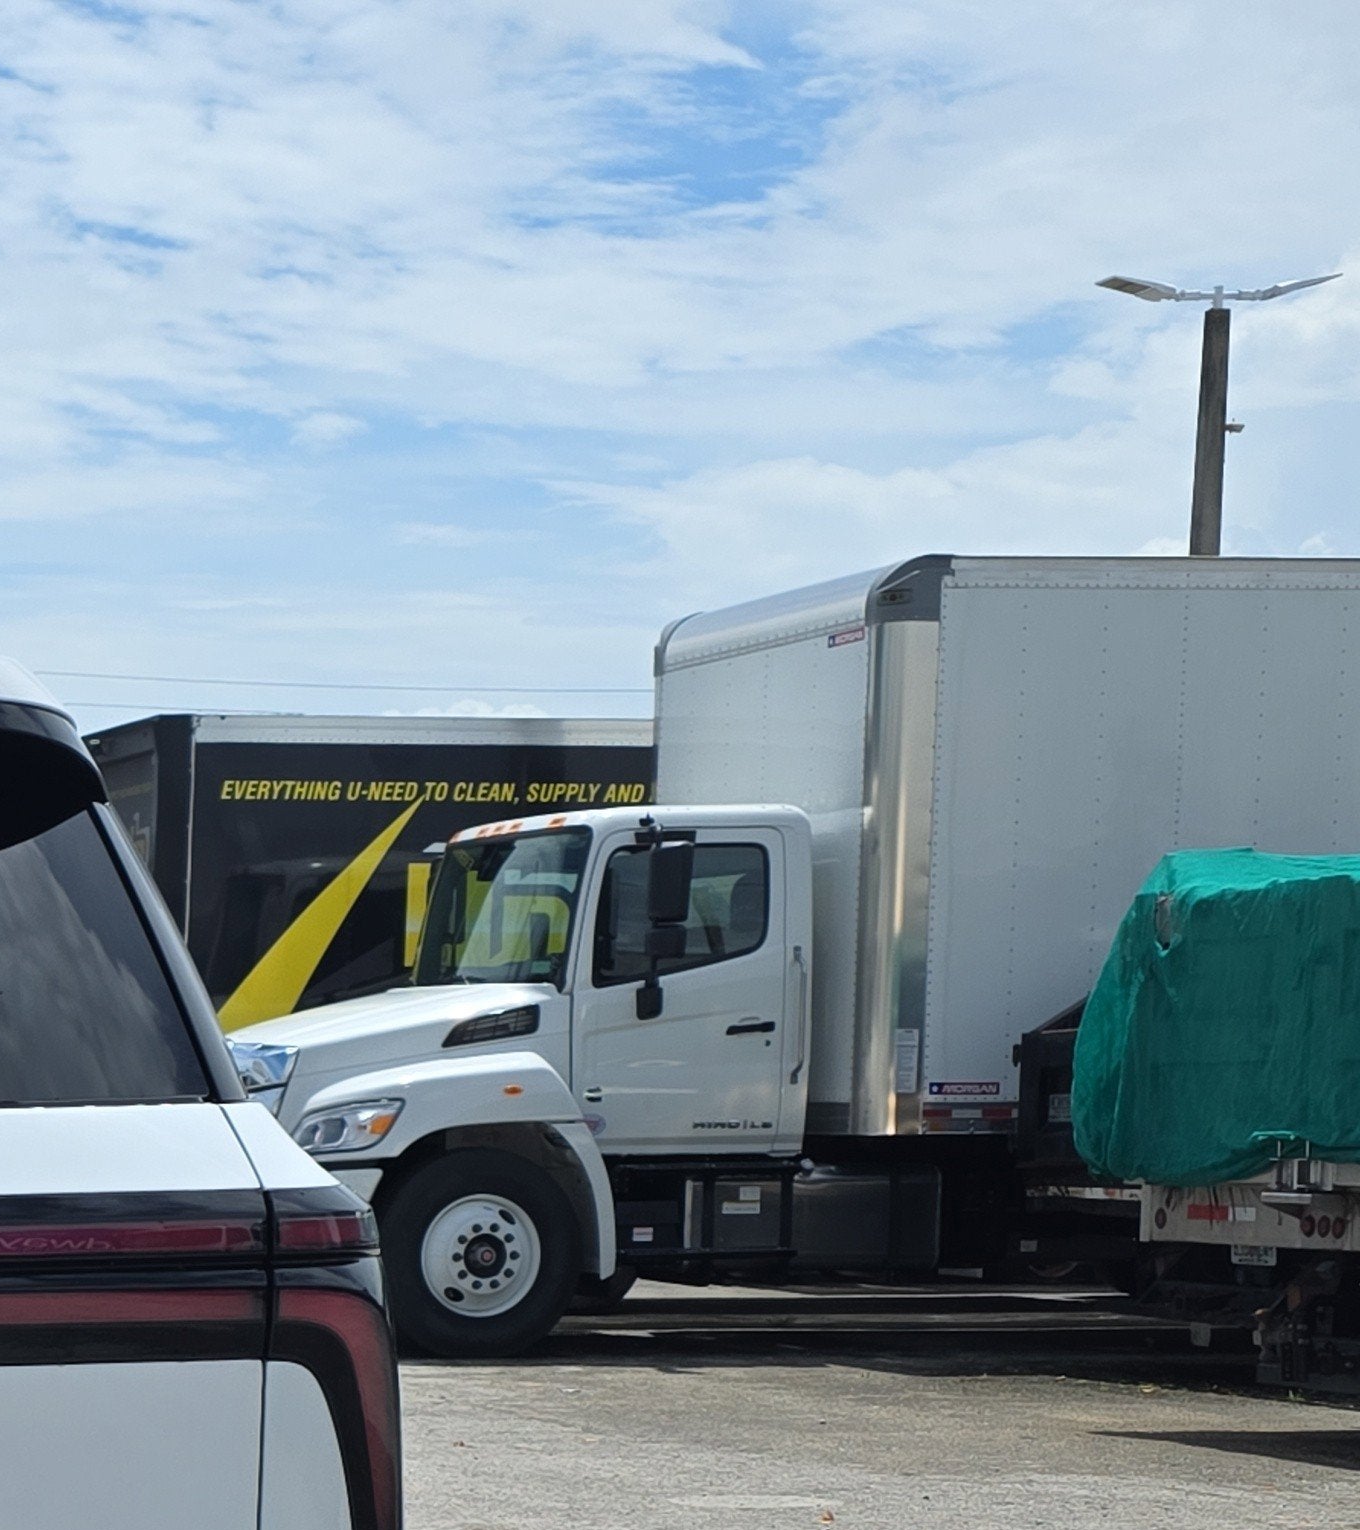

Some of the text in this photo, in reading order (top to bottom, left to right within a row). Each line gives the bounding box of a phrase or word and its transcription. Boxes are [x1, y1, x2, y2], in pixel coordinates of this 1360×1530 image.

[220, 780, 342, 801] EVERYTHING
[346, 781, 419, 802] U-NEED
[423, 781, 449, 802] TO
[453, 782, 520, 804] CLEAN,
[526, 783, 602, 803] SUPPLY
[603, 783, 646, 803] AND
[941, 1084, 997, 1094] MORGAN
